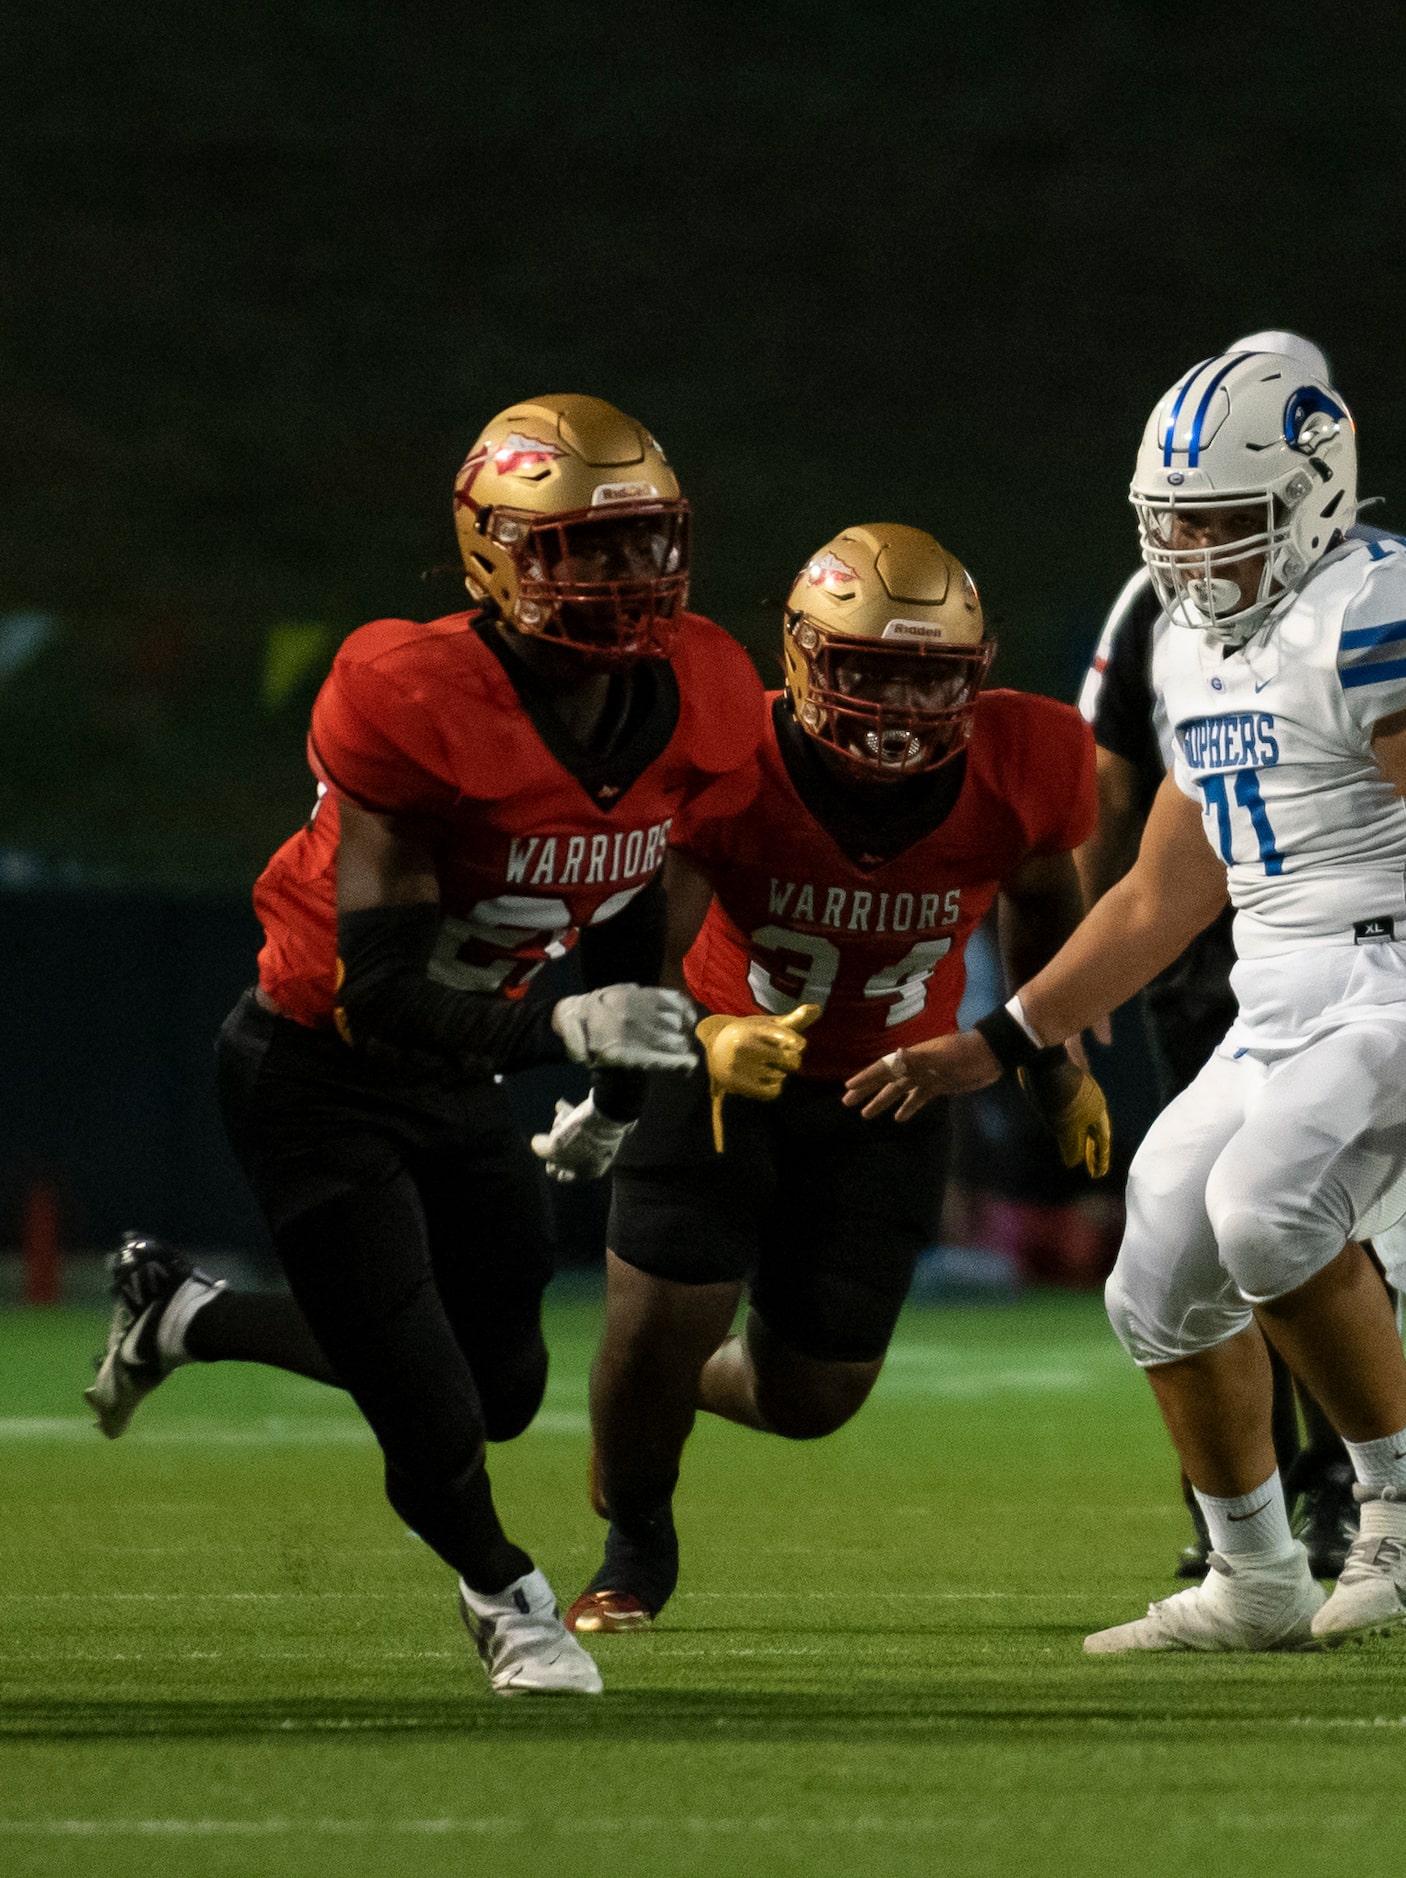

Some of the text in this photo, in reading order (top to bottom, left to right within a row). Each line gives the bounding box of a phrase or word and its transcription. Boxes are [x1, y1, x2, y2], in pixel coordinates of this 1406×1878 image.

[769, 877, 961, 931] WARRIORS
[1364, 923, 1385, 935] XL
[747, 923, 952, 1028] 34
